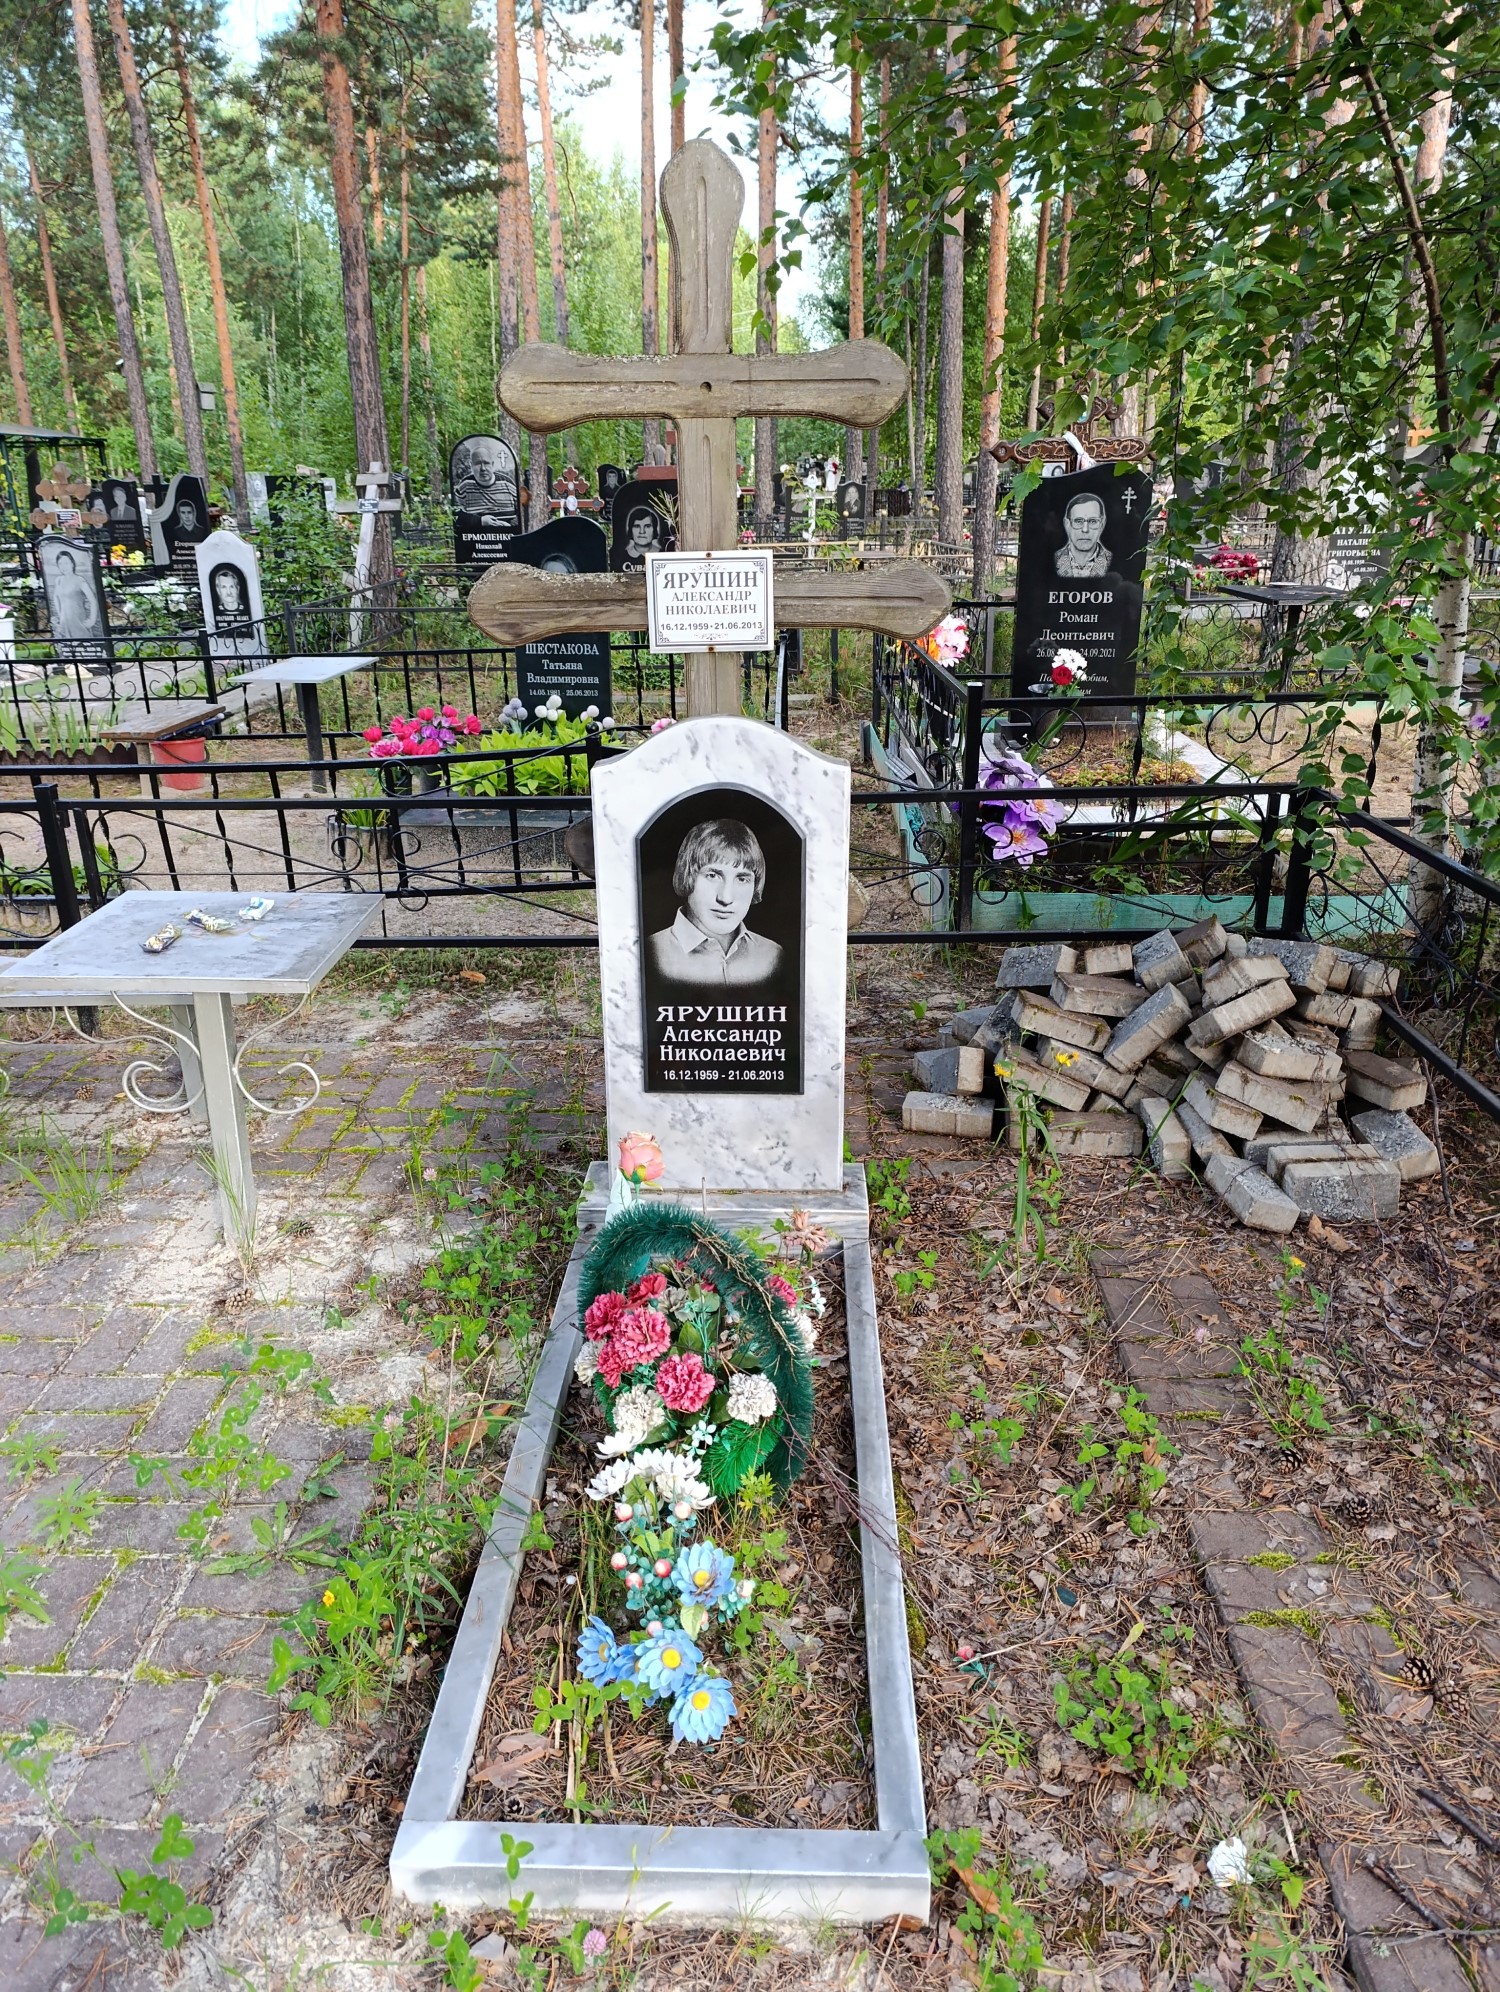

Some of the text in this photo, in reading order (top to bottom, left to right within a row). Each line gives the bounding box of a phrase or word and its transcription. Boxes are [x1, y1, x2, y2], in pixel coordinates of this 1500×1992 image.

[1337, 538, 1372, 547] НАТАЛИ
[662, 571, 758, 589] ЯРУШИН
[671, 591, 752, 602] АЛЕКСАНДР
[1048, 591, 1113, 604] ЕГОРОВ
[665, 604, 757, 615] НИКОЛАЕВИЧ
[1059, 611, 1099, 623] Роман
[1039, 629, 1115, 641] Леонтьевич
[525, 643, 599, 655] ШЕСТАКОВА
[541, 659, 583, 670] Татьяна
[526, 672, 600, 685] Владимировна
[566, 689, 599, 697] 25.06.2013
[656, 1006, 787, 1022] ЯРУШИН
[662, 1025, 782, 1046] Александр
[660, 1045, 786, 1061] Николаевич
[663, 1070, 719, 1080] 16.12.1959
[728, 1070, 785, 1080] 21.06.2013
